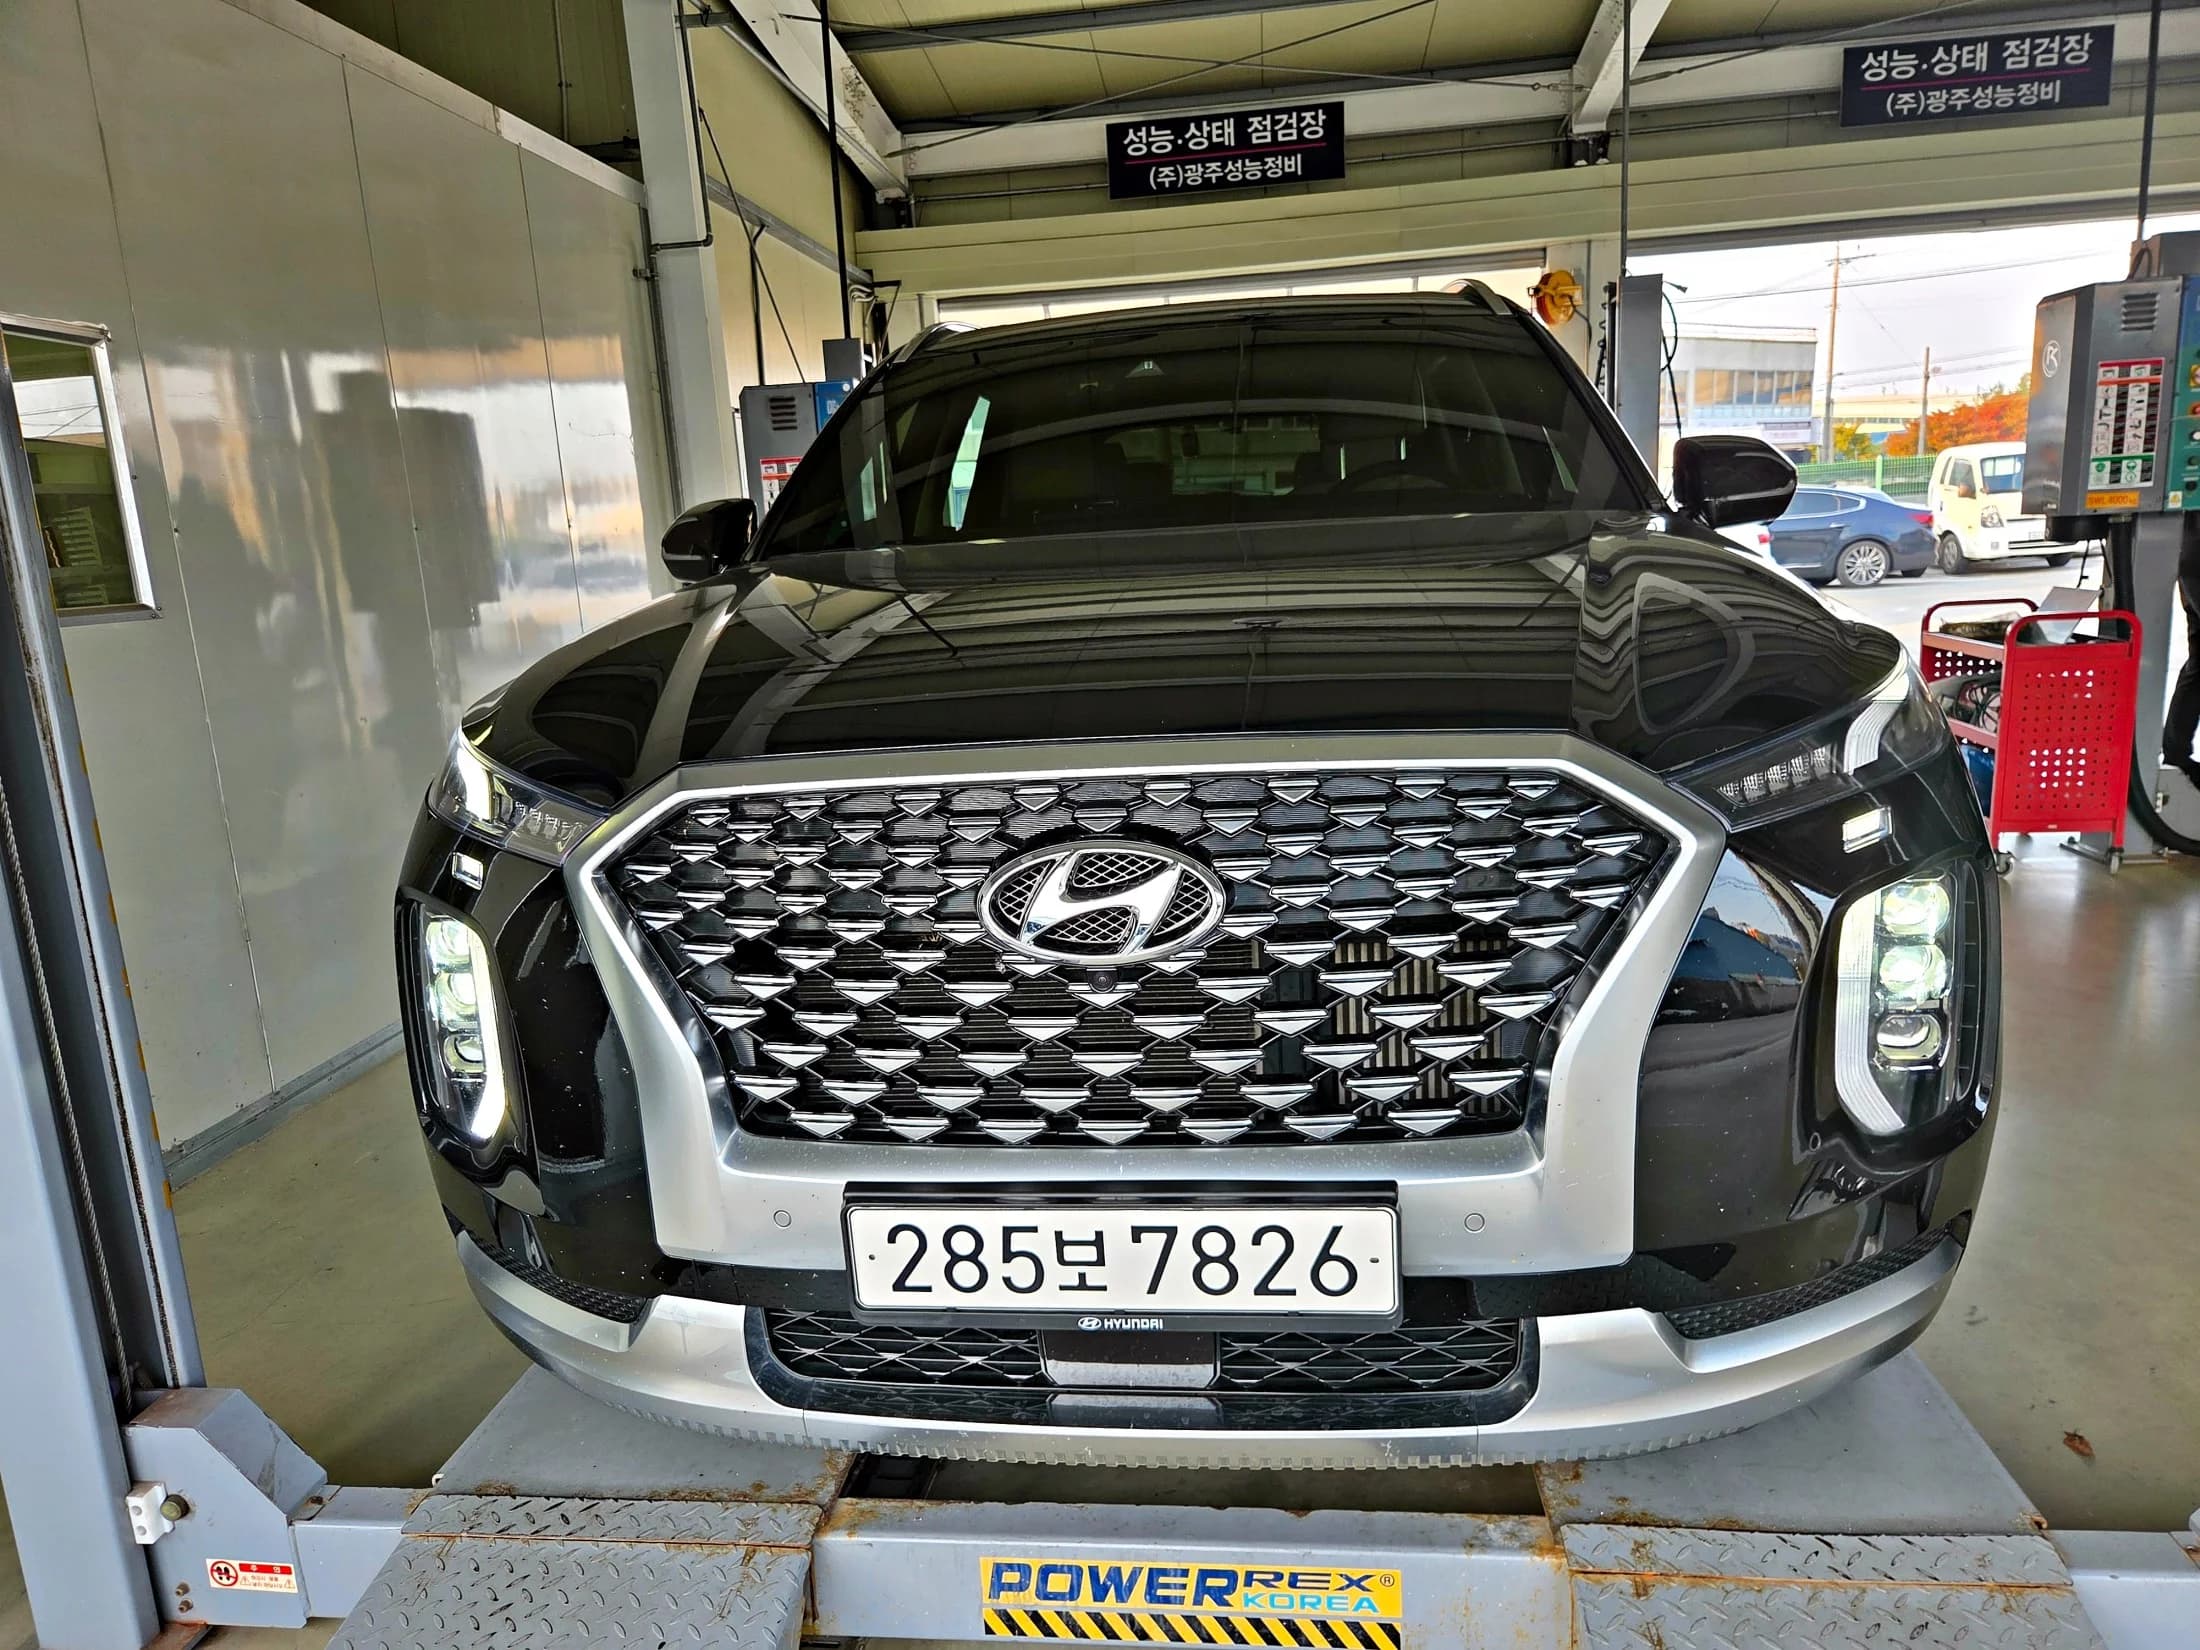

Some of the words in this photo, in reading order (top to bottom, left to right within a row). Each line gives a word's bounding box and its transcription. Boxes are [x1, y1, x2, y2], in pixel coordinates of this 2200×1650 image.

[2001, 32, 2094, 70] 점검장
[1885, 79, 2062, 117] (주)광주성능정비
[1246, 108, 1328, 145] 점검장
[1148, 153, 1303, 190] (주)광주성능정비
[1103, 1317, 1165, 1331] HYUNDAI
[1242, 1592, 1381, 1614] KOREA
